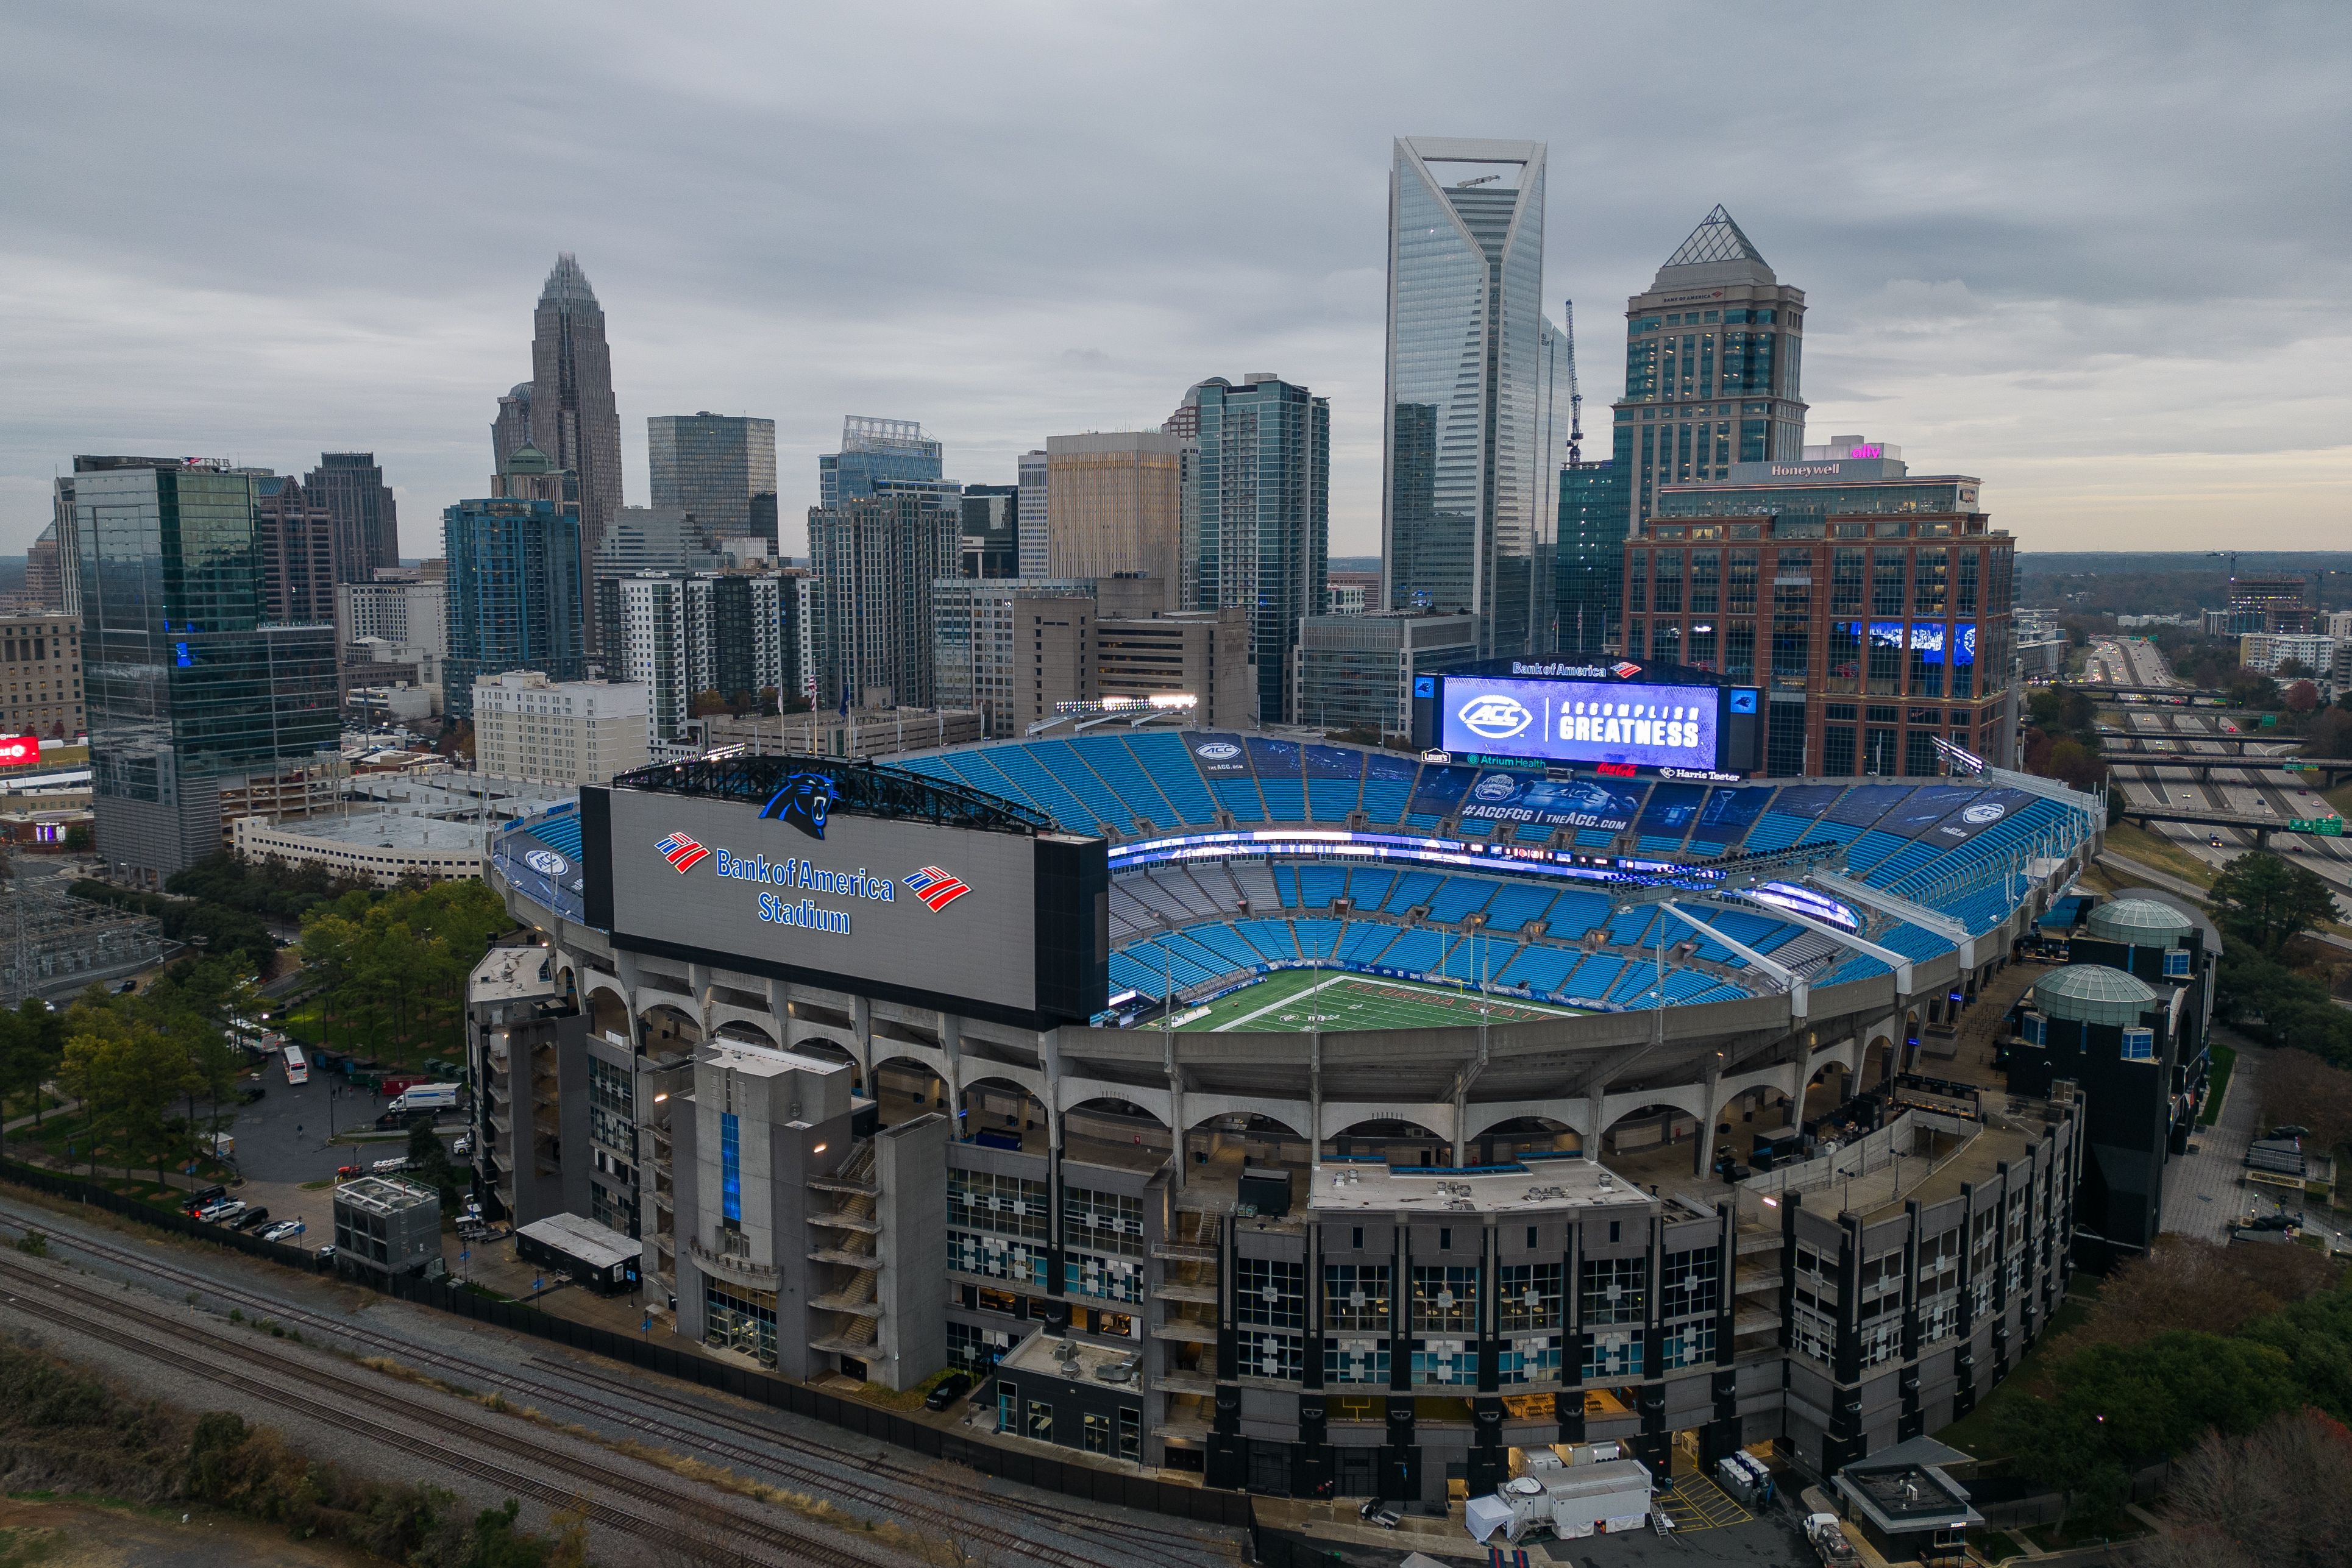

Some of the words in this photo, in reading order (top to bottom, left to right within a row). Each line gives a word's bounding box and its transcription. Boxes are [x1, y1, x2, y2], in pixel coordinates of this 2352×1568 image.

[1852, 444, 1880, 459] ally
[204, 458, 232, 467] FNB
[1772, 463, 1839, 477] Honeywell
[1513, 662, 1543, 675] Bank
[1543, 662, 1557, 675] of
[1556, 663, 1607, 677] America
[1467, 705, 1522, 723] ACC
[1560, 701, 1699, 720] ACCOMPLISH
[1559, 716, 1699, 748] GREATNESS
[1424, 753, 1448, 762] LOWE'S
[1480, 755, 1514, 766] Atrium
[1515, 757, 1546, 768] Health
[1675, 769, 1707, 779] Harris
[1708, 772, 1739, 782] Teeter
[1462, 804, 1532, 821] #ACCFCG
[536, 853, 557, 869] ACC
[716, 848, 771, 884] Bank
[772, 858, 795, 887] of
[798, 860, 895, 902] America
[758, 892, 850, 935] Stadium
[1346, 982, 1455, 1006] FLORIDA
[1463, 1002, 1558, 1020] STATE
